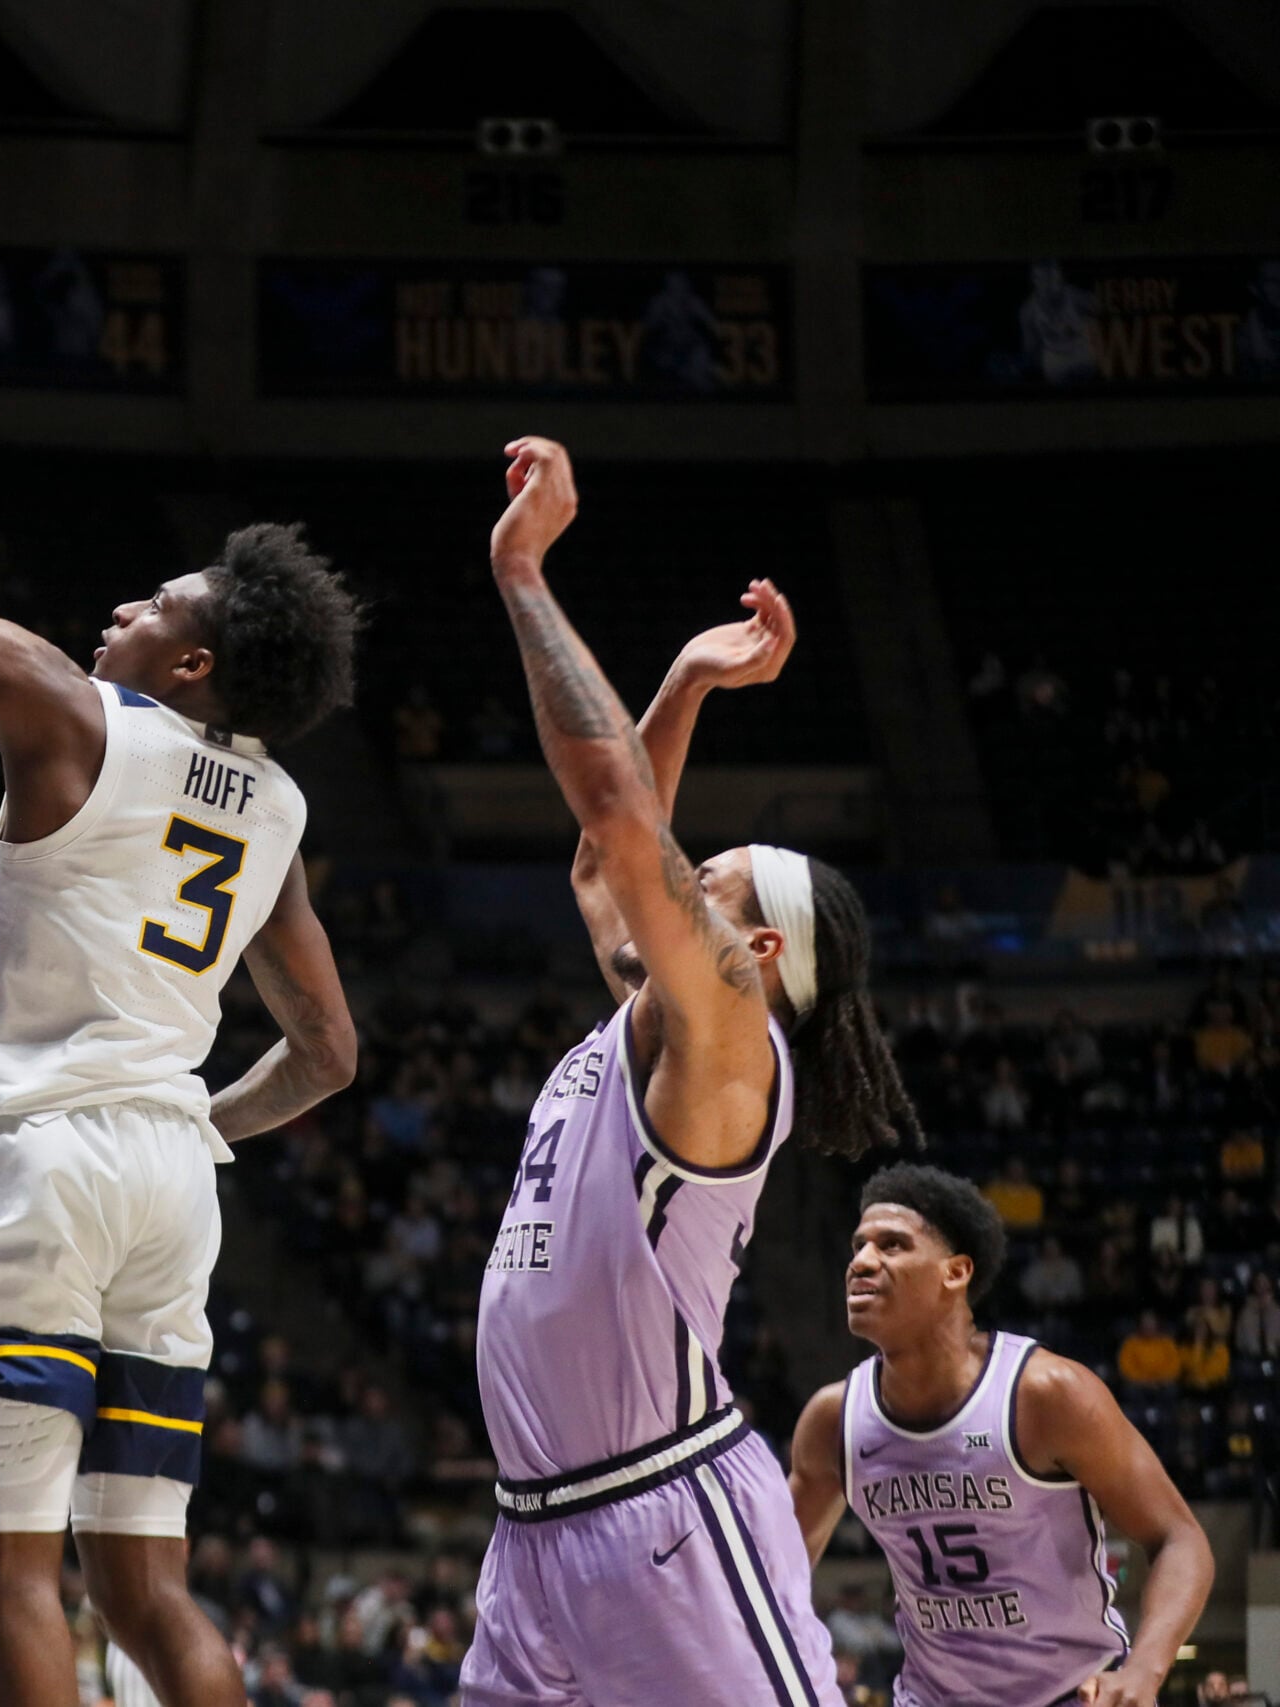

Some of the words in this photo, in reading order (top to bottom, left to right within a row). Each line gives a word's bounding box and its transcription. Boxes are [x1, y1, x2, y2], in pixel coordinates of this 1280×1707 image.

[466, 171, 563, 223] 216
[1083, 168, 1172, 223] 217
[99, 308, 169, 374] 44
[396, 320, 642, 384] HUNDLEY
[718, 320, 780, 384] 33
[1089, 311, 1241, 379] WEST
[183, 752, 257, 815] HUFF
[137, 812, 250, 977] 3
[861, 1471, 1017, 1521] KANSAS
[906, 1522, 990, 1586] 15
[915, 1588, 1028, 1631] STATE
